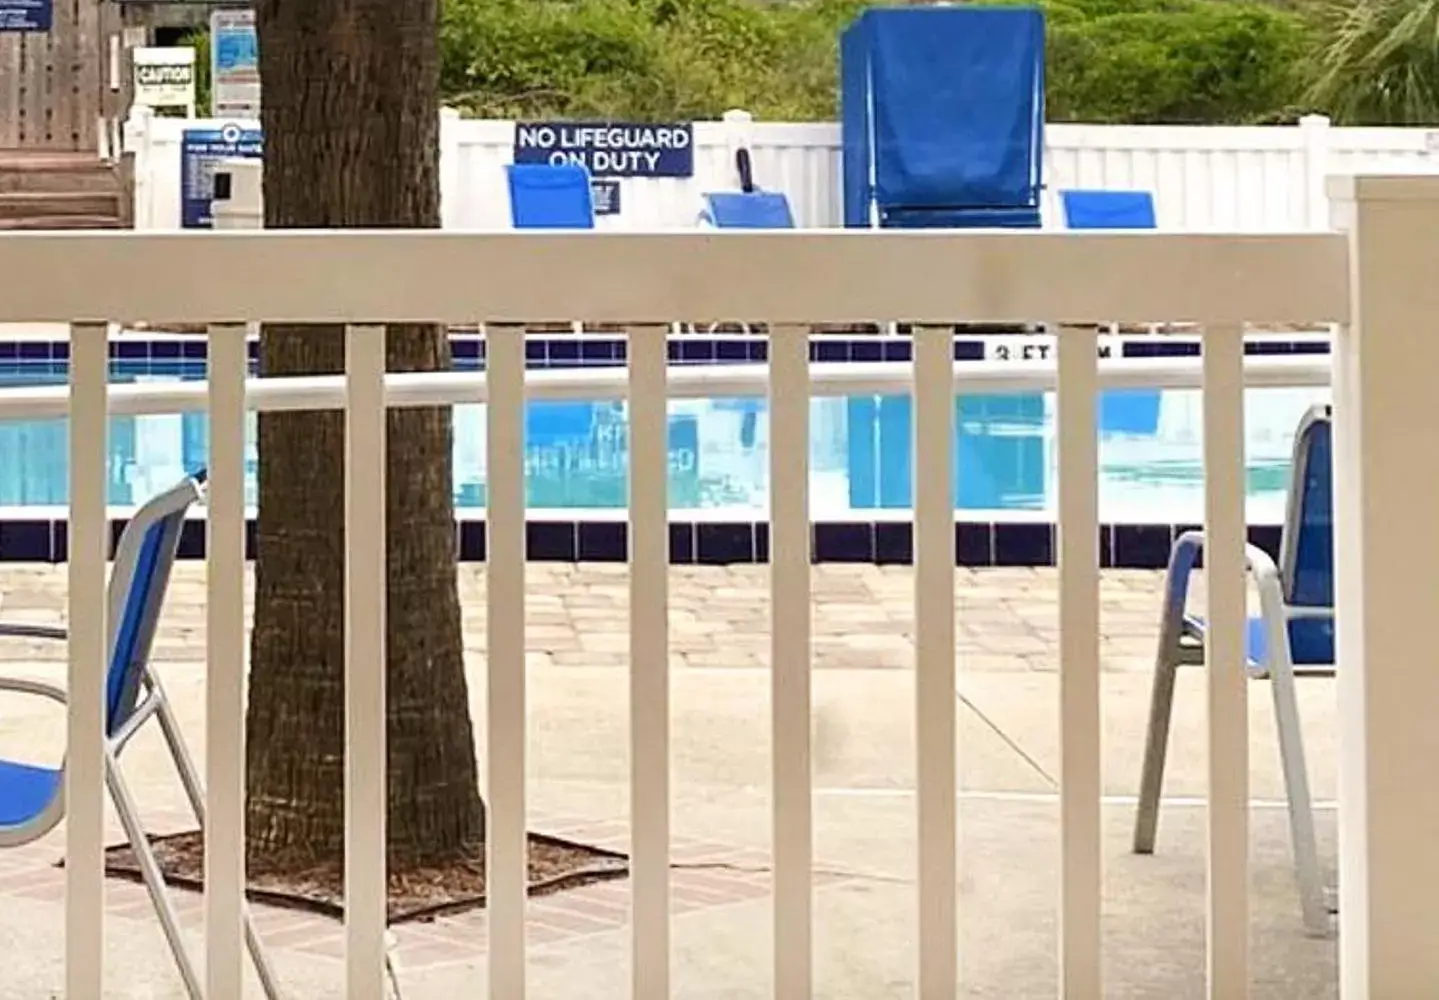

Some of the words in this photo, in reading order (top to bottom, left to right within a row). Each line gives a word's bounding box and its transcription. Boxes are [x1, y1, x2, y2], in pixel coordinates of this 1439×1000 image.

[186, 144, 208, 152] FOR
[209, 144, 237, 152] YOUR
[518, 127, 556, 148] NO
[561, 127, 689, 149] LIFEGUARD
[593, 151, 661, 172] DUTY
